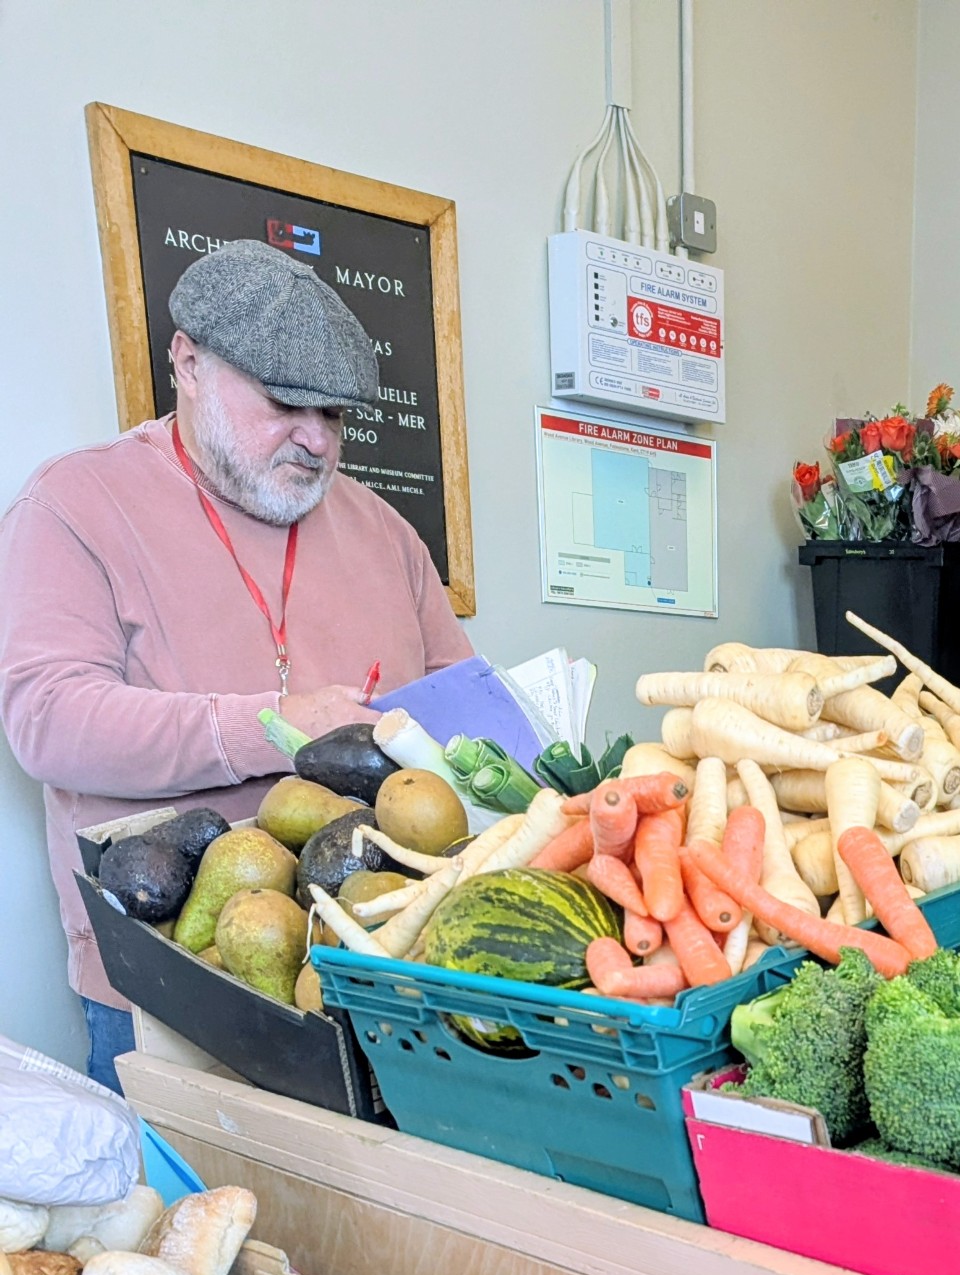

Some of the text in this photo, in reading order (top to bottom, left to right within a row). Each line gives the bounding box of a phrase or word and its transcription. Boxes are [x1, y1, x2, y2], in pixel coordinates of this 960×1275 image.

[164, 227, 228, 254] ARCH
[335, 265, 406, 297] MAYOR
[640, 282, 707, 307] FIRE ALARM SYSTEM
[635, 311, 650, 324] tfs
[370, 338, 393, 356] AS
[378, 386, 418, 406] UELLE
[398, 412, 426, 431] MER
[343, 426, 378, 444] 1960
[578, 423, 678, 451] FIRE ALARM ZONE PLAN
